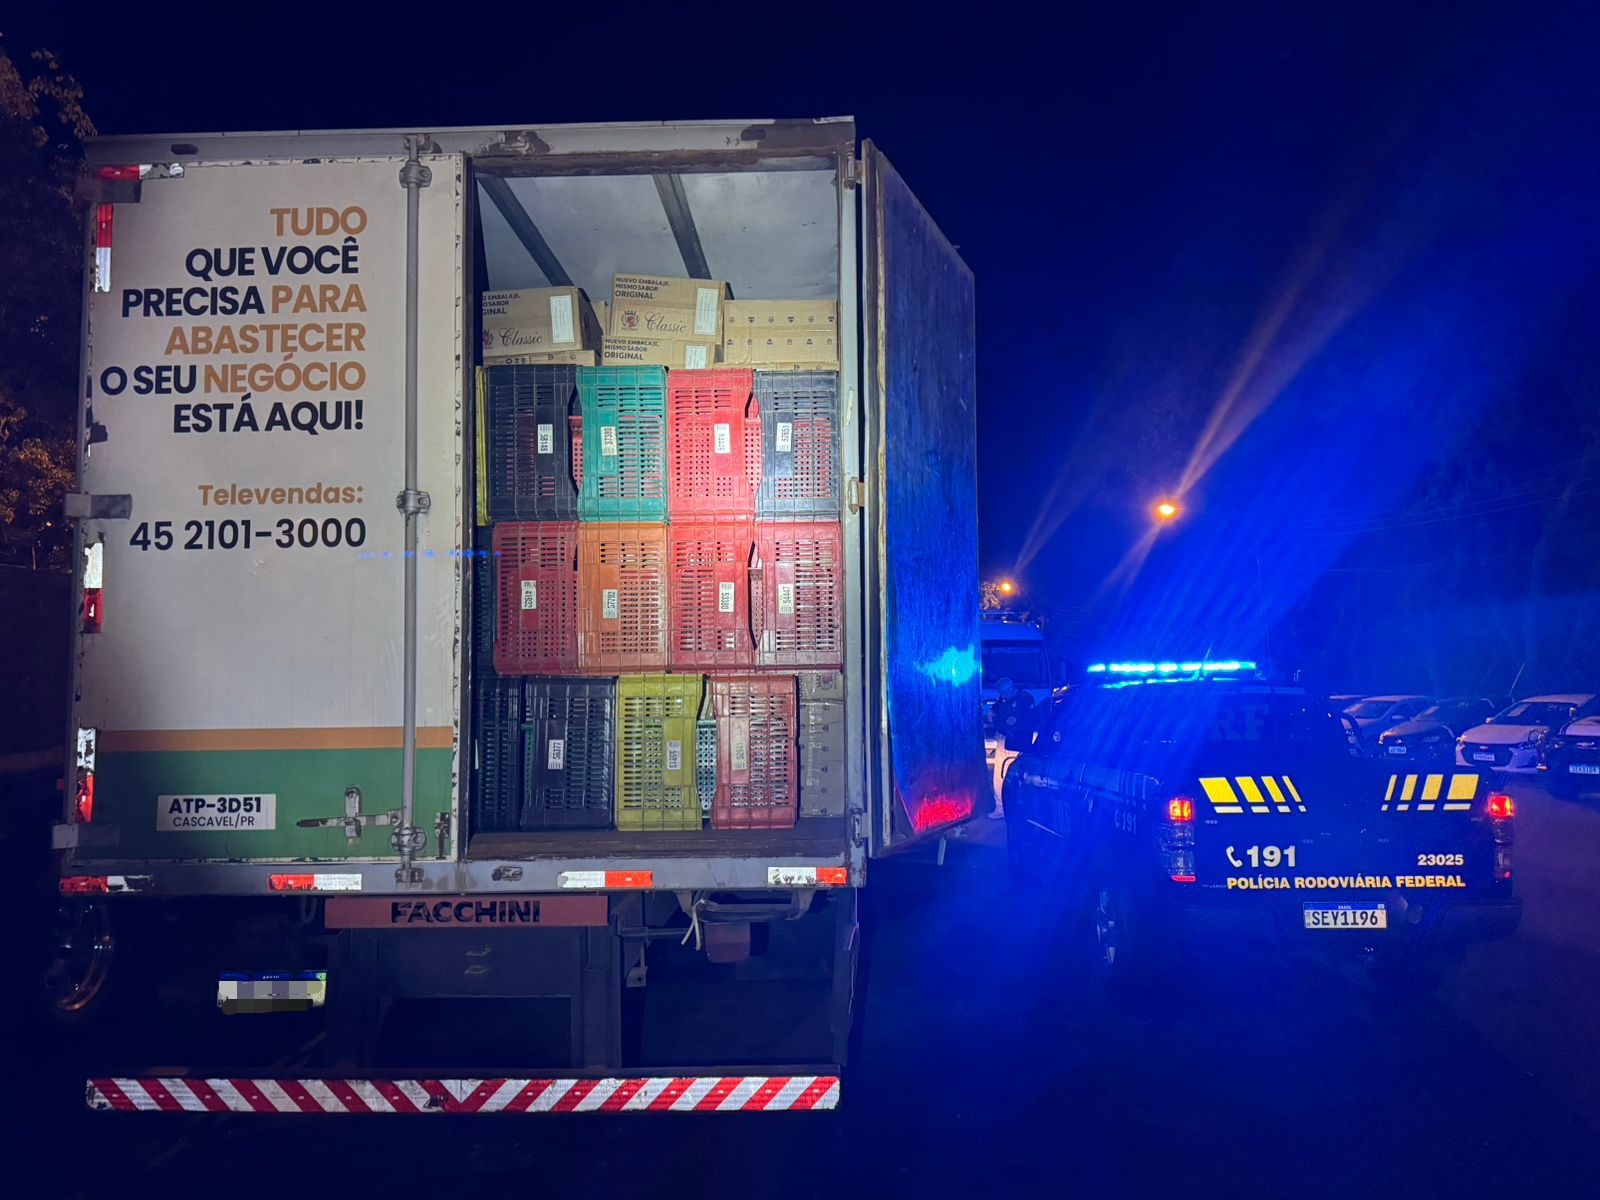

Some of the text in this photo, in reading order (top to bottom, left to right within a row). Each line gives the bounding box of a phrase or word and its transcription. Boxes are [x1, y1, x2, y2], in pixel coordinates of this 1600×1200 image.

[269, 206, 367, 237] TUDO
[185, 236, 359, 281] QUE VOCÊ
[121, 284, 367, 317] PRECISA PARA
[615, 290, 654, 299] ORIGINAL
[644, 311, 687, 333] Classic
[164, 322, 366, 355] ABASTECER
[498, 327, 543, 349] Classic
[604, 351, 644, 360] ORIGINAL
[100, 352, 366, 395] O SEU NEGÓCIO
[173, 392, 363, 435] ESTÁ AQUI!
[198, 482, 363, 506] Televendas:
[129, 517, 366, 551] 45 2101-3000
[168, 797, 262, 814] ATP-3D51
[173, 813, 255, 828] CASCAVEL/PR
[1246, 845, 1296, 868] 191
[1417, 854, 1464, 866] 23025
[1226, 873, 1466, 889] POLÍCIA RODOVIÁRIA FEDERAL
[391, 900, 541, 923] FACCHINI
[1311, 910, 1379, 926] SEY1I96
